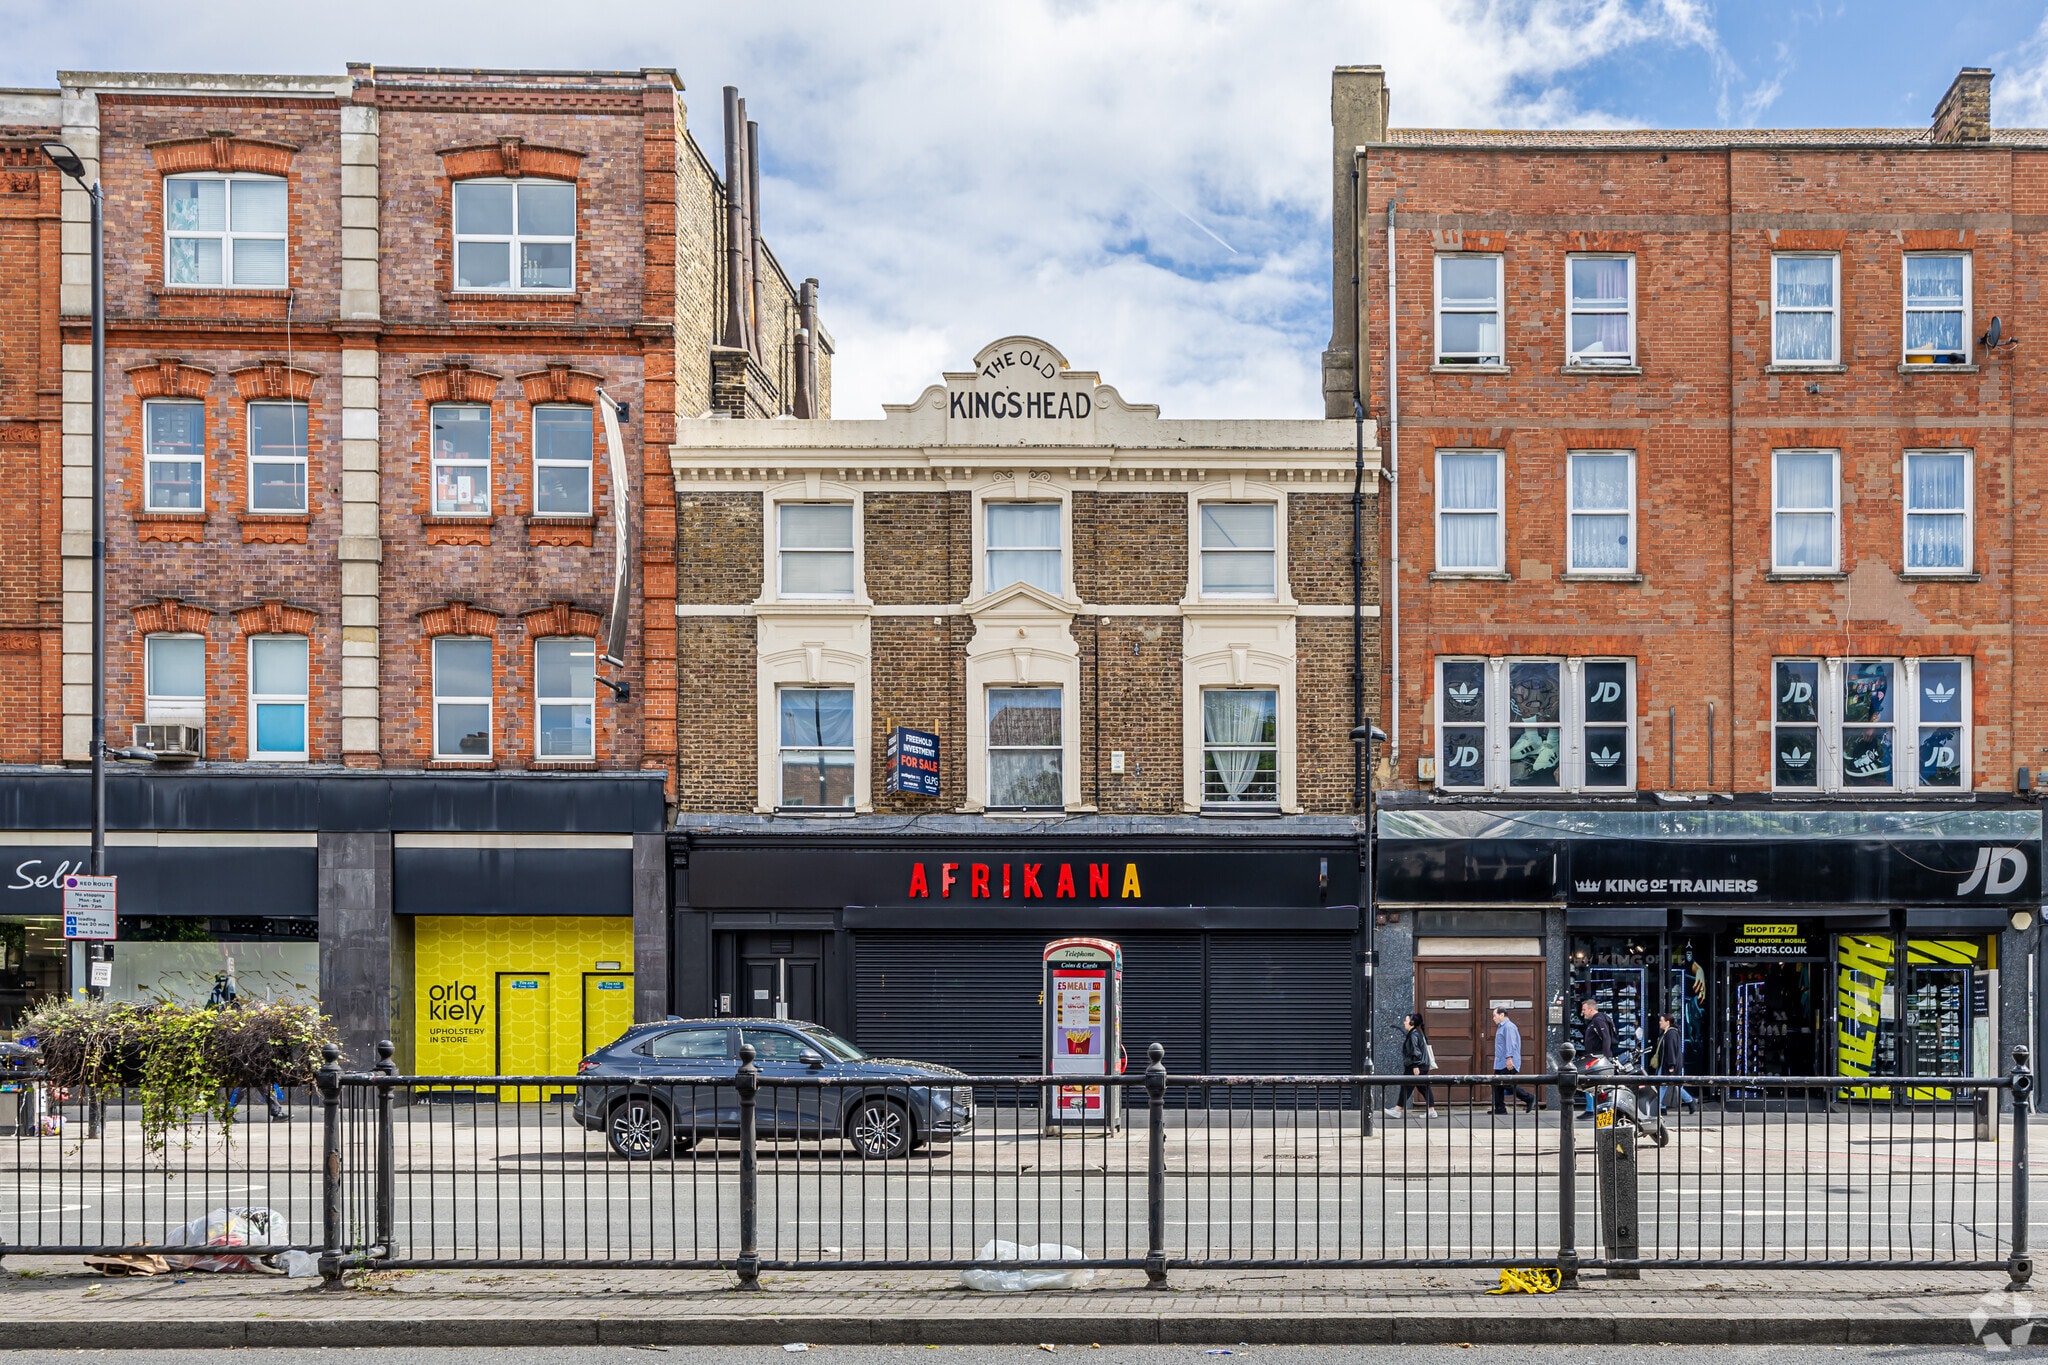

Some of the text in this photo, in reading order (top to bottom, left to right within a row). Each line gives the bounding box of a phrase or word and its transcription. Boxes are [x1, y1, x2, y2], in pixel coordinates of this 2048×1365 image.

[982, 350, 1056, 379] THE OLD
[1027, 392, 1091, 419] HEAD
[1590, 682, 1621, 703] JD
[1782, 682, 1812, 703] JD
[903, 743, 935, 757] INVESTMENT
[905, 734, 933, 747] FREEHOLD
[901, 754, 938, 772] FOR SALE
[1449, 746, 1479, 767] JD
[1924, 747, 1955, 768] JD
[908, 863, 1142, 899] AFRIKANA
[1957, 847, 2028, 896] JD
[1605, 879, 1759, 893] KING OF TRAINERS
[1065, 950, 1095, 958] Telephone
[1734, 946, 1807, 954] JDSPORTS.CO.UK
[429, 981, 476, 1000] orla
[1057, 982, 1067, 990] £5
[1067, 982, 1088, 990] MEAL
[430, 1000, 485, 1025] kiely
